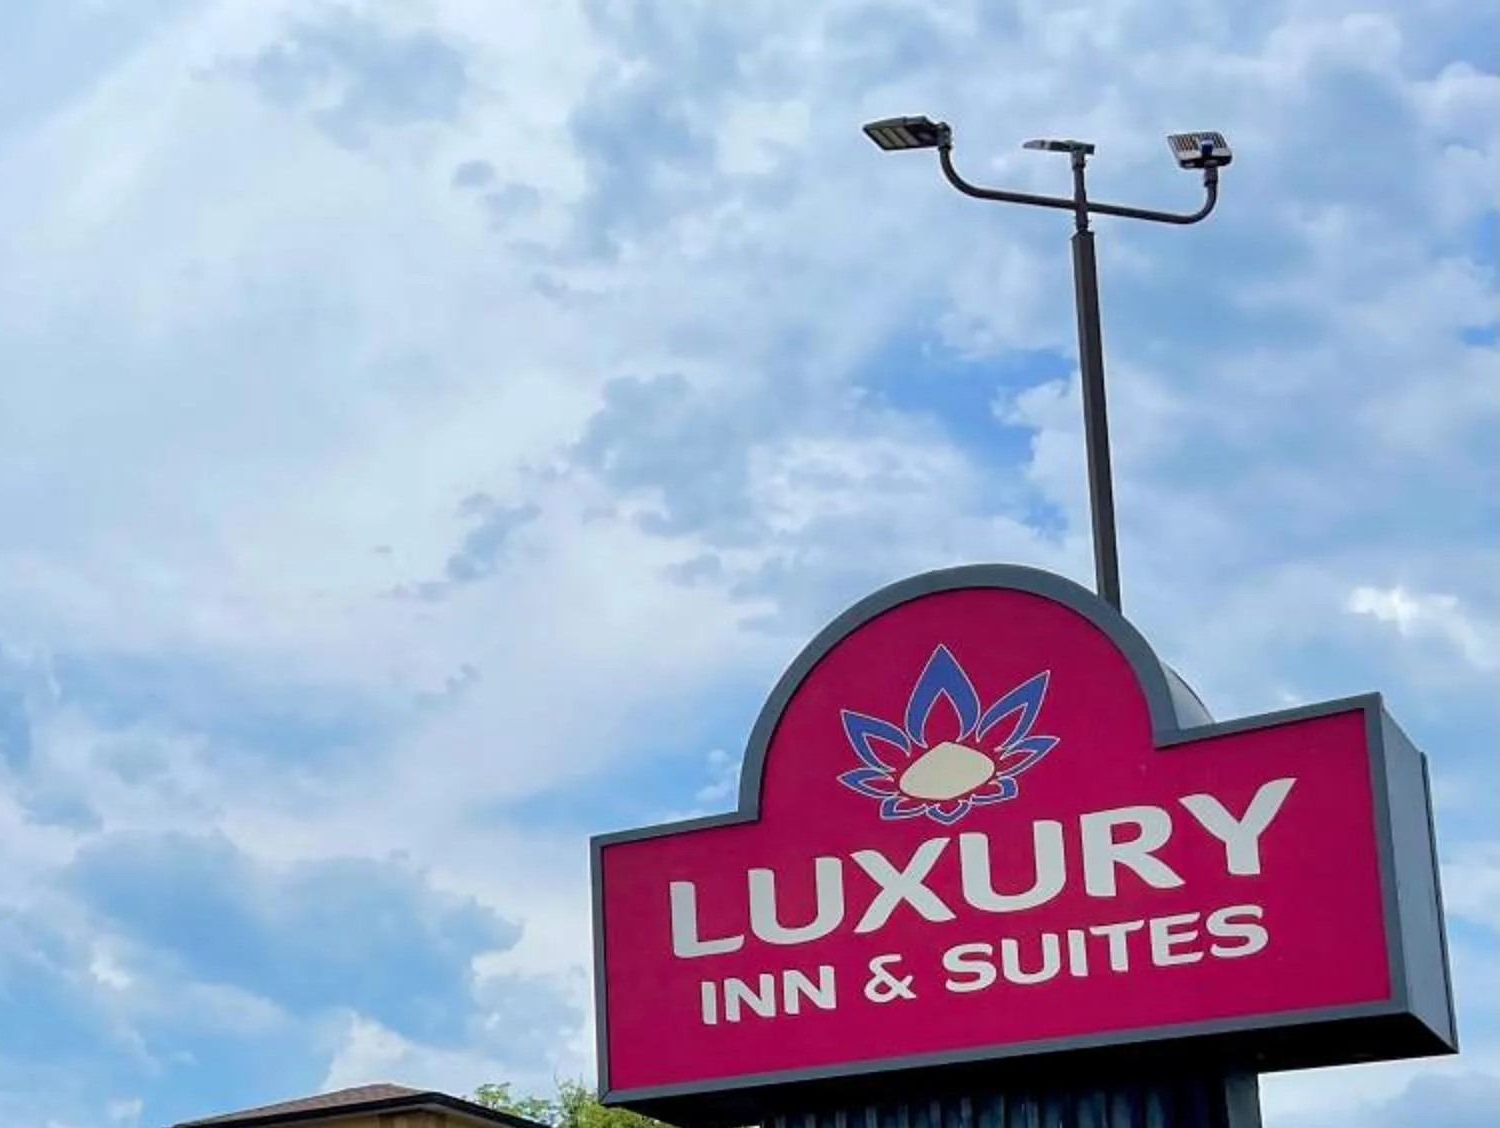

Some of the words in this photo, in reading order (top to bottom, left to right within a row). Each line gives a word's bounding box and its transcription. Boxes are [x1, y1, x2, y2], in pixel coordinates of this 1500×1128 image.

[669, 777, 1297, 959] LUXURY
[700, 964, 837, 1026] INN
[863, 953, 917, 1004] &
[942, 903, 1270, 994] SUITES
